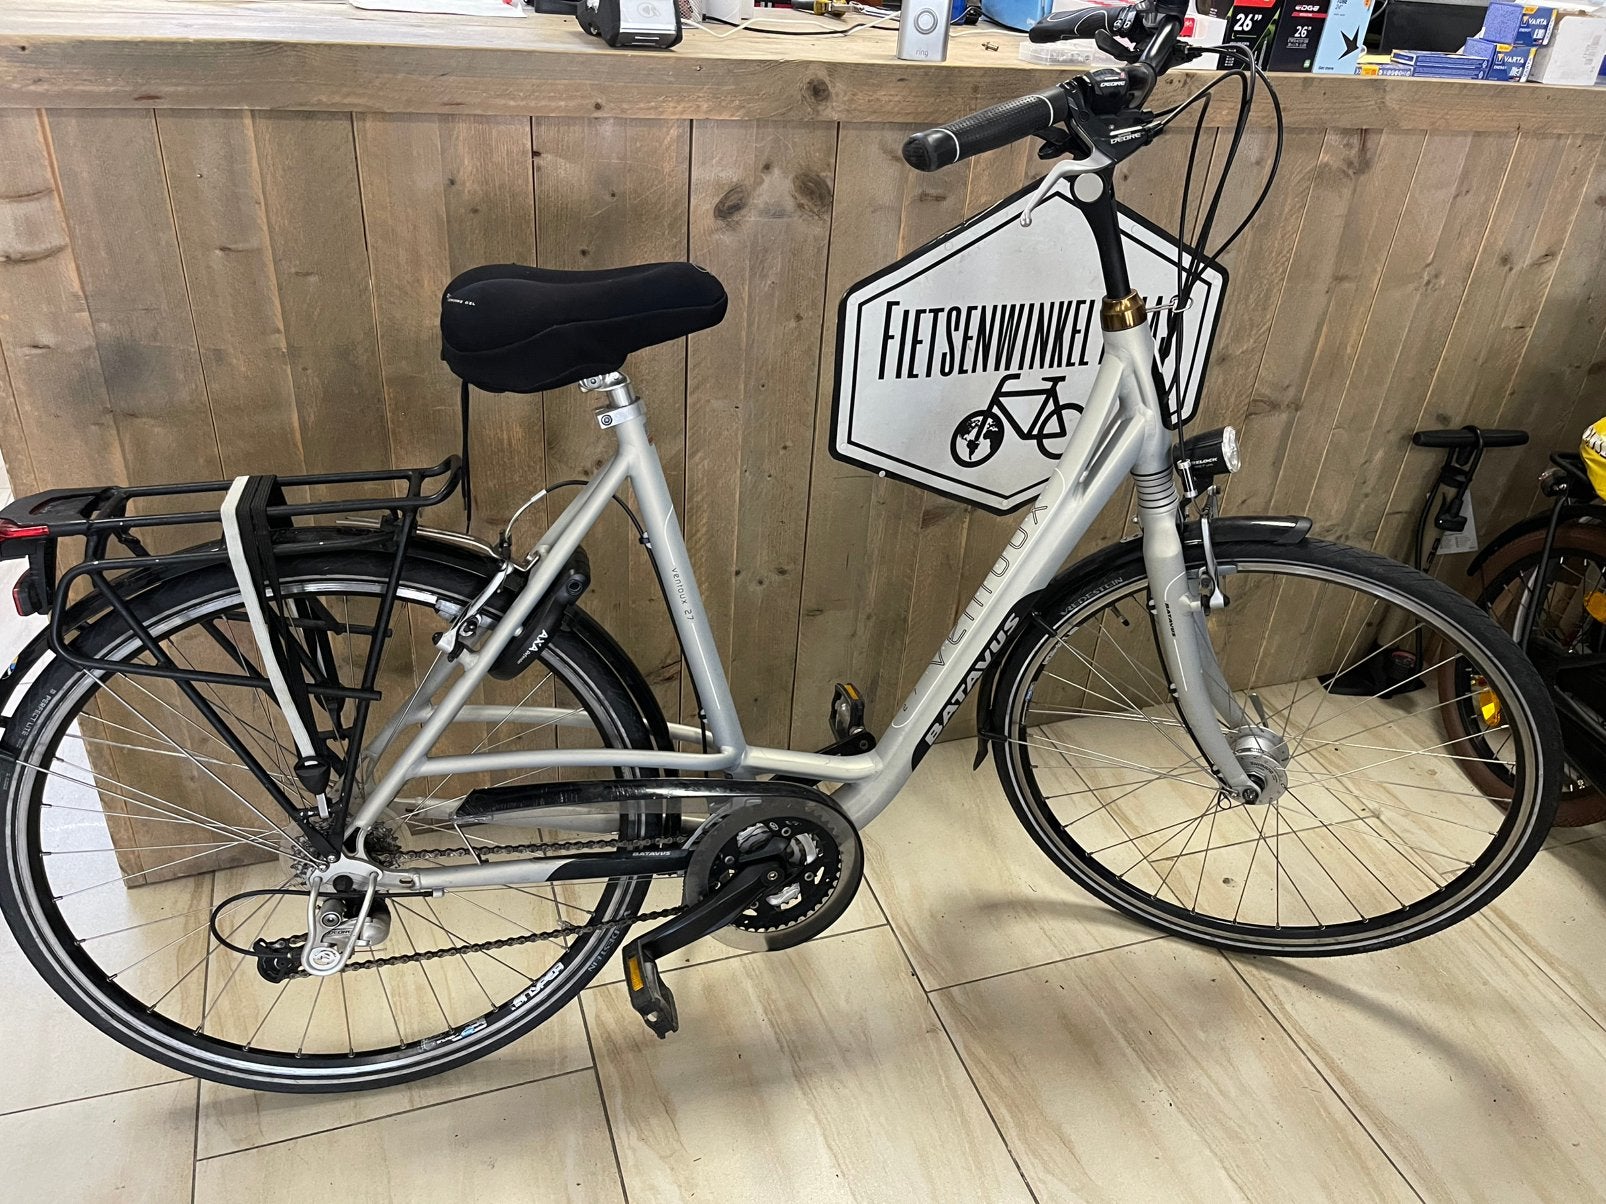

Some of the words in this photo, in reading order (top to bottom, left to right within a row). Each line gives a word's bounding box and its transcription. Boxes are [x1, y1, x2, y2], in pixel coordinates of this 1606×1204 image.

[1528, 18, 1547, 26] VARTA
[915, 49, 929, 58] ring
[1504, 55, 1525, 64] VARTA
[1110, 132, 1141, 144] DEORE
[877, 299, 1096, 380] FIETSENWINKEL
[529, 628, 549, 652] AXA
[925, 612, 1020, 746] BATAVUS
